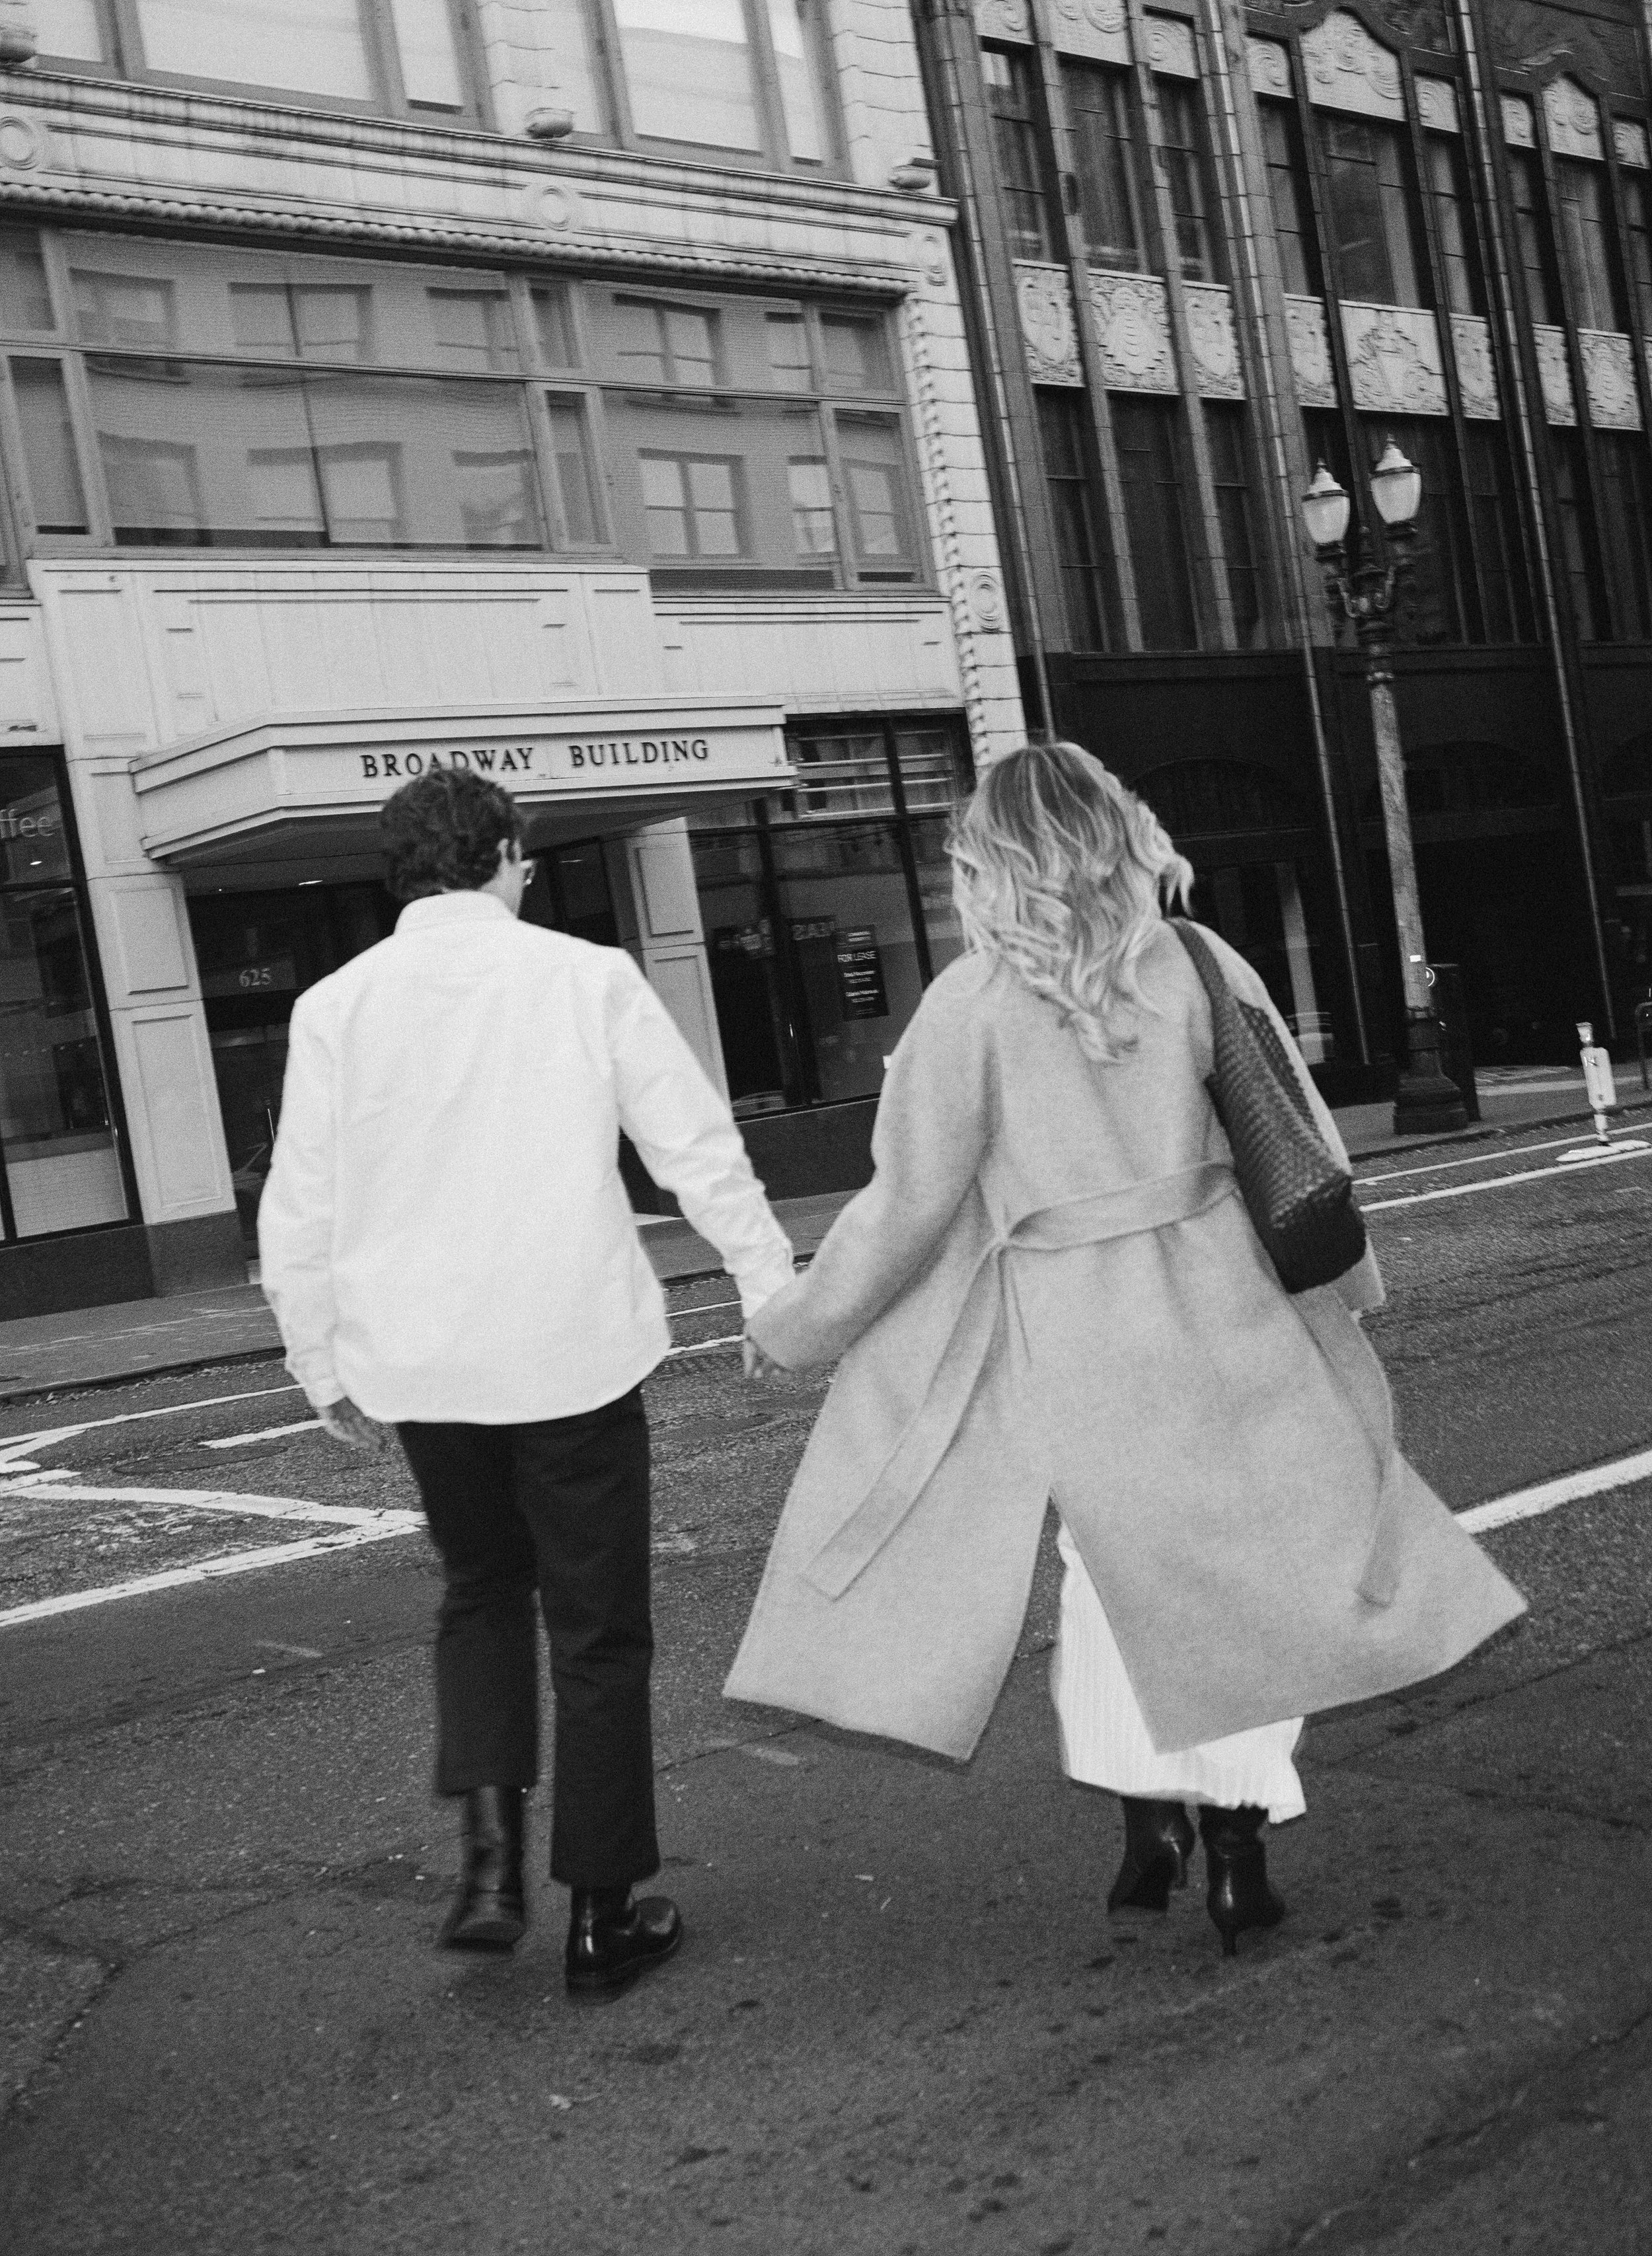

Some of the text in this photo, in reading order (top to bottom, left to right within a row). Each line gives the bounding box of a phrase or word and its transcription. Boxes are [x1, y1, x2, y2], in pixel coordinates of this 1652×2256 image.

[360, 739, 709, 777] BROADWAY BUILDING
[837, 951, 877, 963] FOR LEASE
[239, 967, 272, 987] 625
